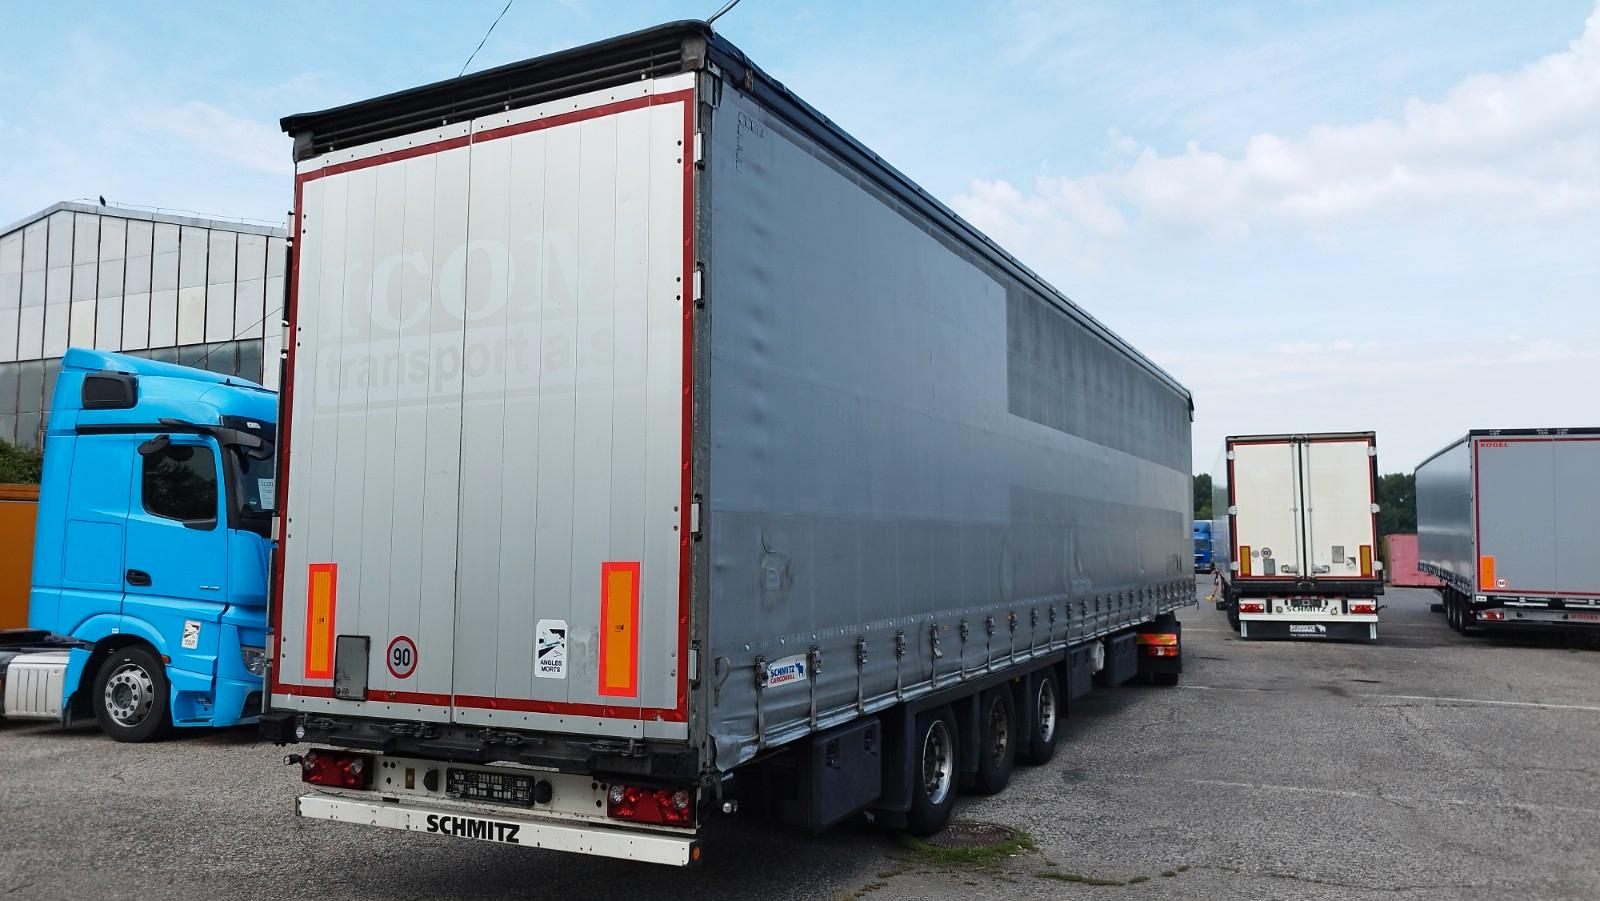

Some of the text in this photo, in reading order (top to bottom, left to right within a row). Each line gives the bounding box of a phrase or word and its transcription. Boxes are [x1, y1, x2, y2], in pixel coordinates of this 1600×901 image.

[393, 648, 410, 667] 90
[770, 665, 795, 676] SCHMITZ
[426, 814, 520, 844] SCHMITZ
